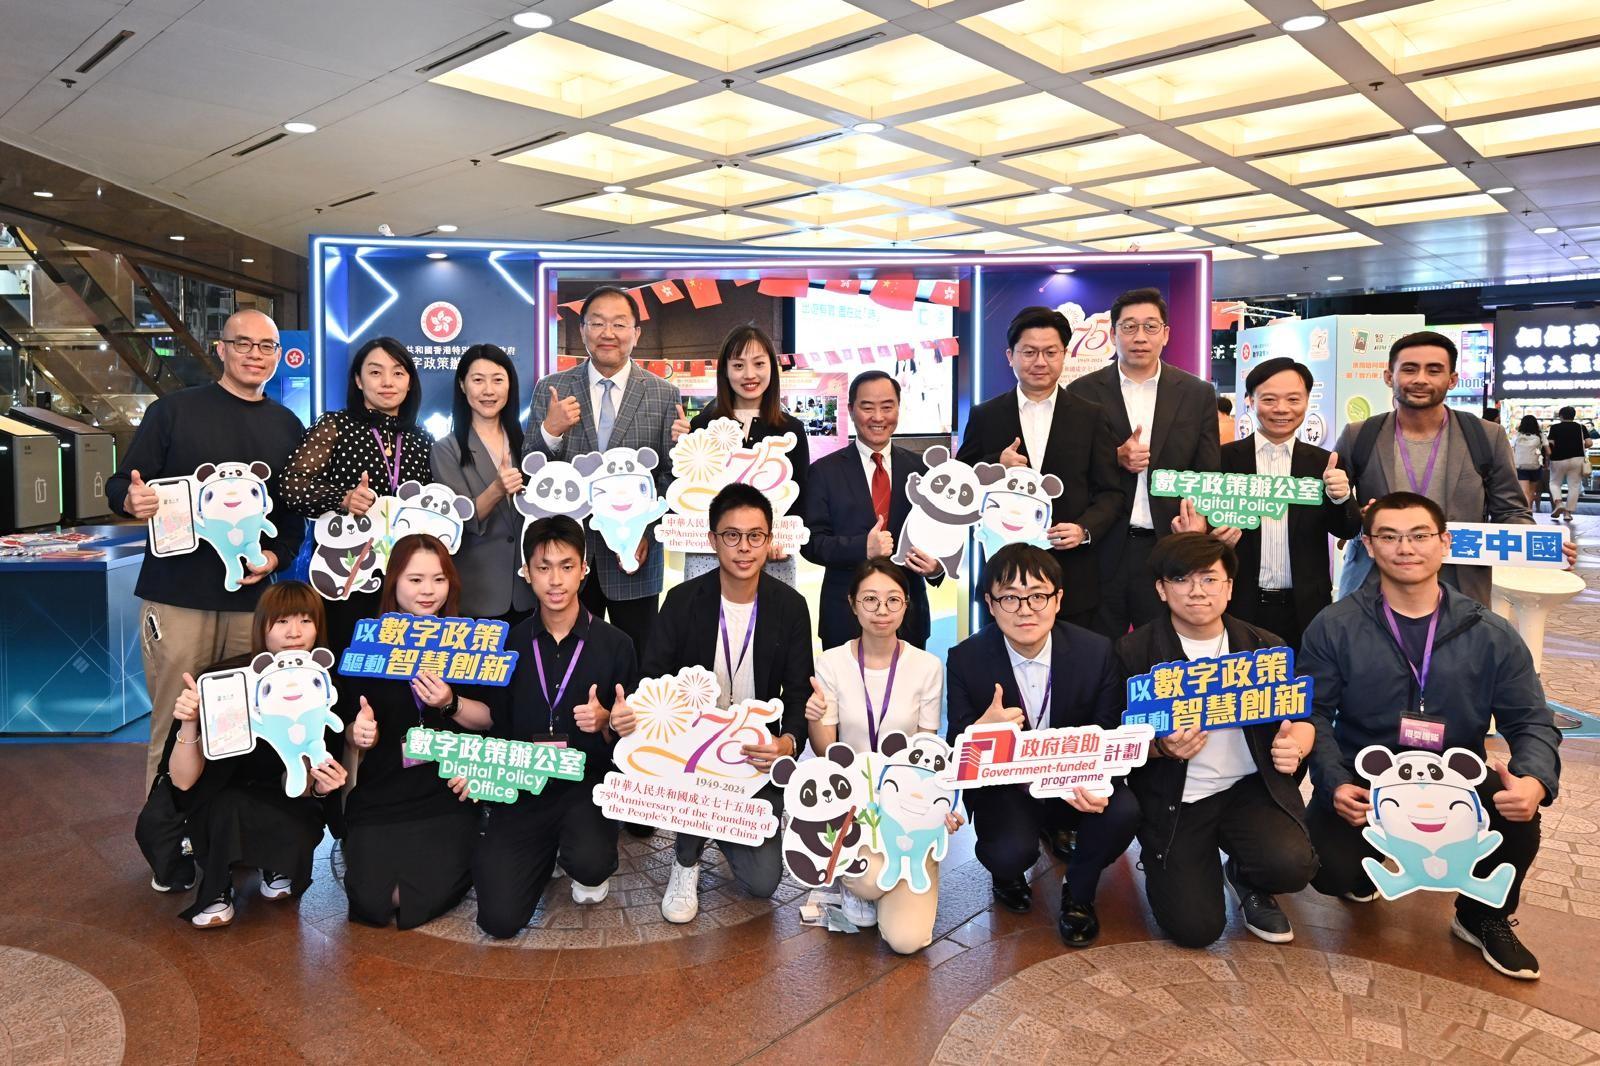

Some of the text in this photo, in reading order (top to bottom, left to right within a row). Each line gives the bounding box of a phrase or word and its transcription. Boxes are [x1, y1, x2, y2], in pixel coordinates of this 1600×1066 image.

[1071, 319, 1110, 358] 75
[725, 438, 792, 492] 75
[1154, 471, 1323, 501] 數字政策辦公室
[1187, 495, 1285, 515] Digital Policy
[1211, 511, 1257, 525] Office
[669, 538, 684, 547] the
[355, 617, 503, 652] 以數字政策
[340, 647, 513, 683] 驅動智慧創新
[1130, 652, 1288, 702] 以數字政策
[409, 730, 584, 776] 數字政策辦公室
[683, 706, 777, 773] 75
[1020, 733, 1100, 758] 政府資助
[1103, 743, 1142, 762] 計劃
[442, 760, 545, 789] Digital Policy
[981, 760, 1097, 779] Government-funded
[1040, 773, 1104, 789] programme
[467, 780, 515, 798] Office
[610, 777, 767, 817] 中華人民共和國成立七十五周年
[695, 777, 746, 795] 1949-2024
[608, 803, 758, 841] the People's Republic of China
[618, 794, 676, 816] Anniversary
[678, 805, 690, 815] of
[692, 807, 708, 818] the
[711, 811, 758, 831] Founding
[760, 821, 773, 832] of
